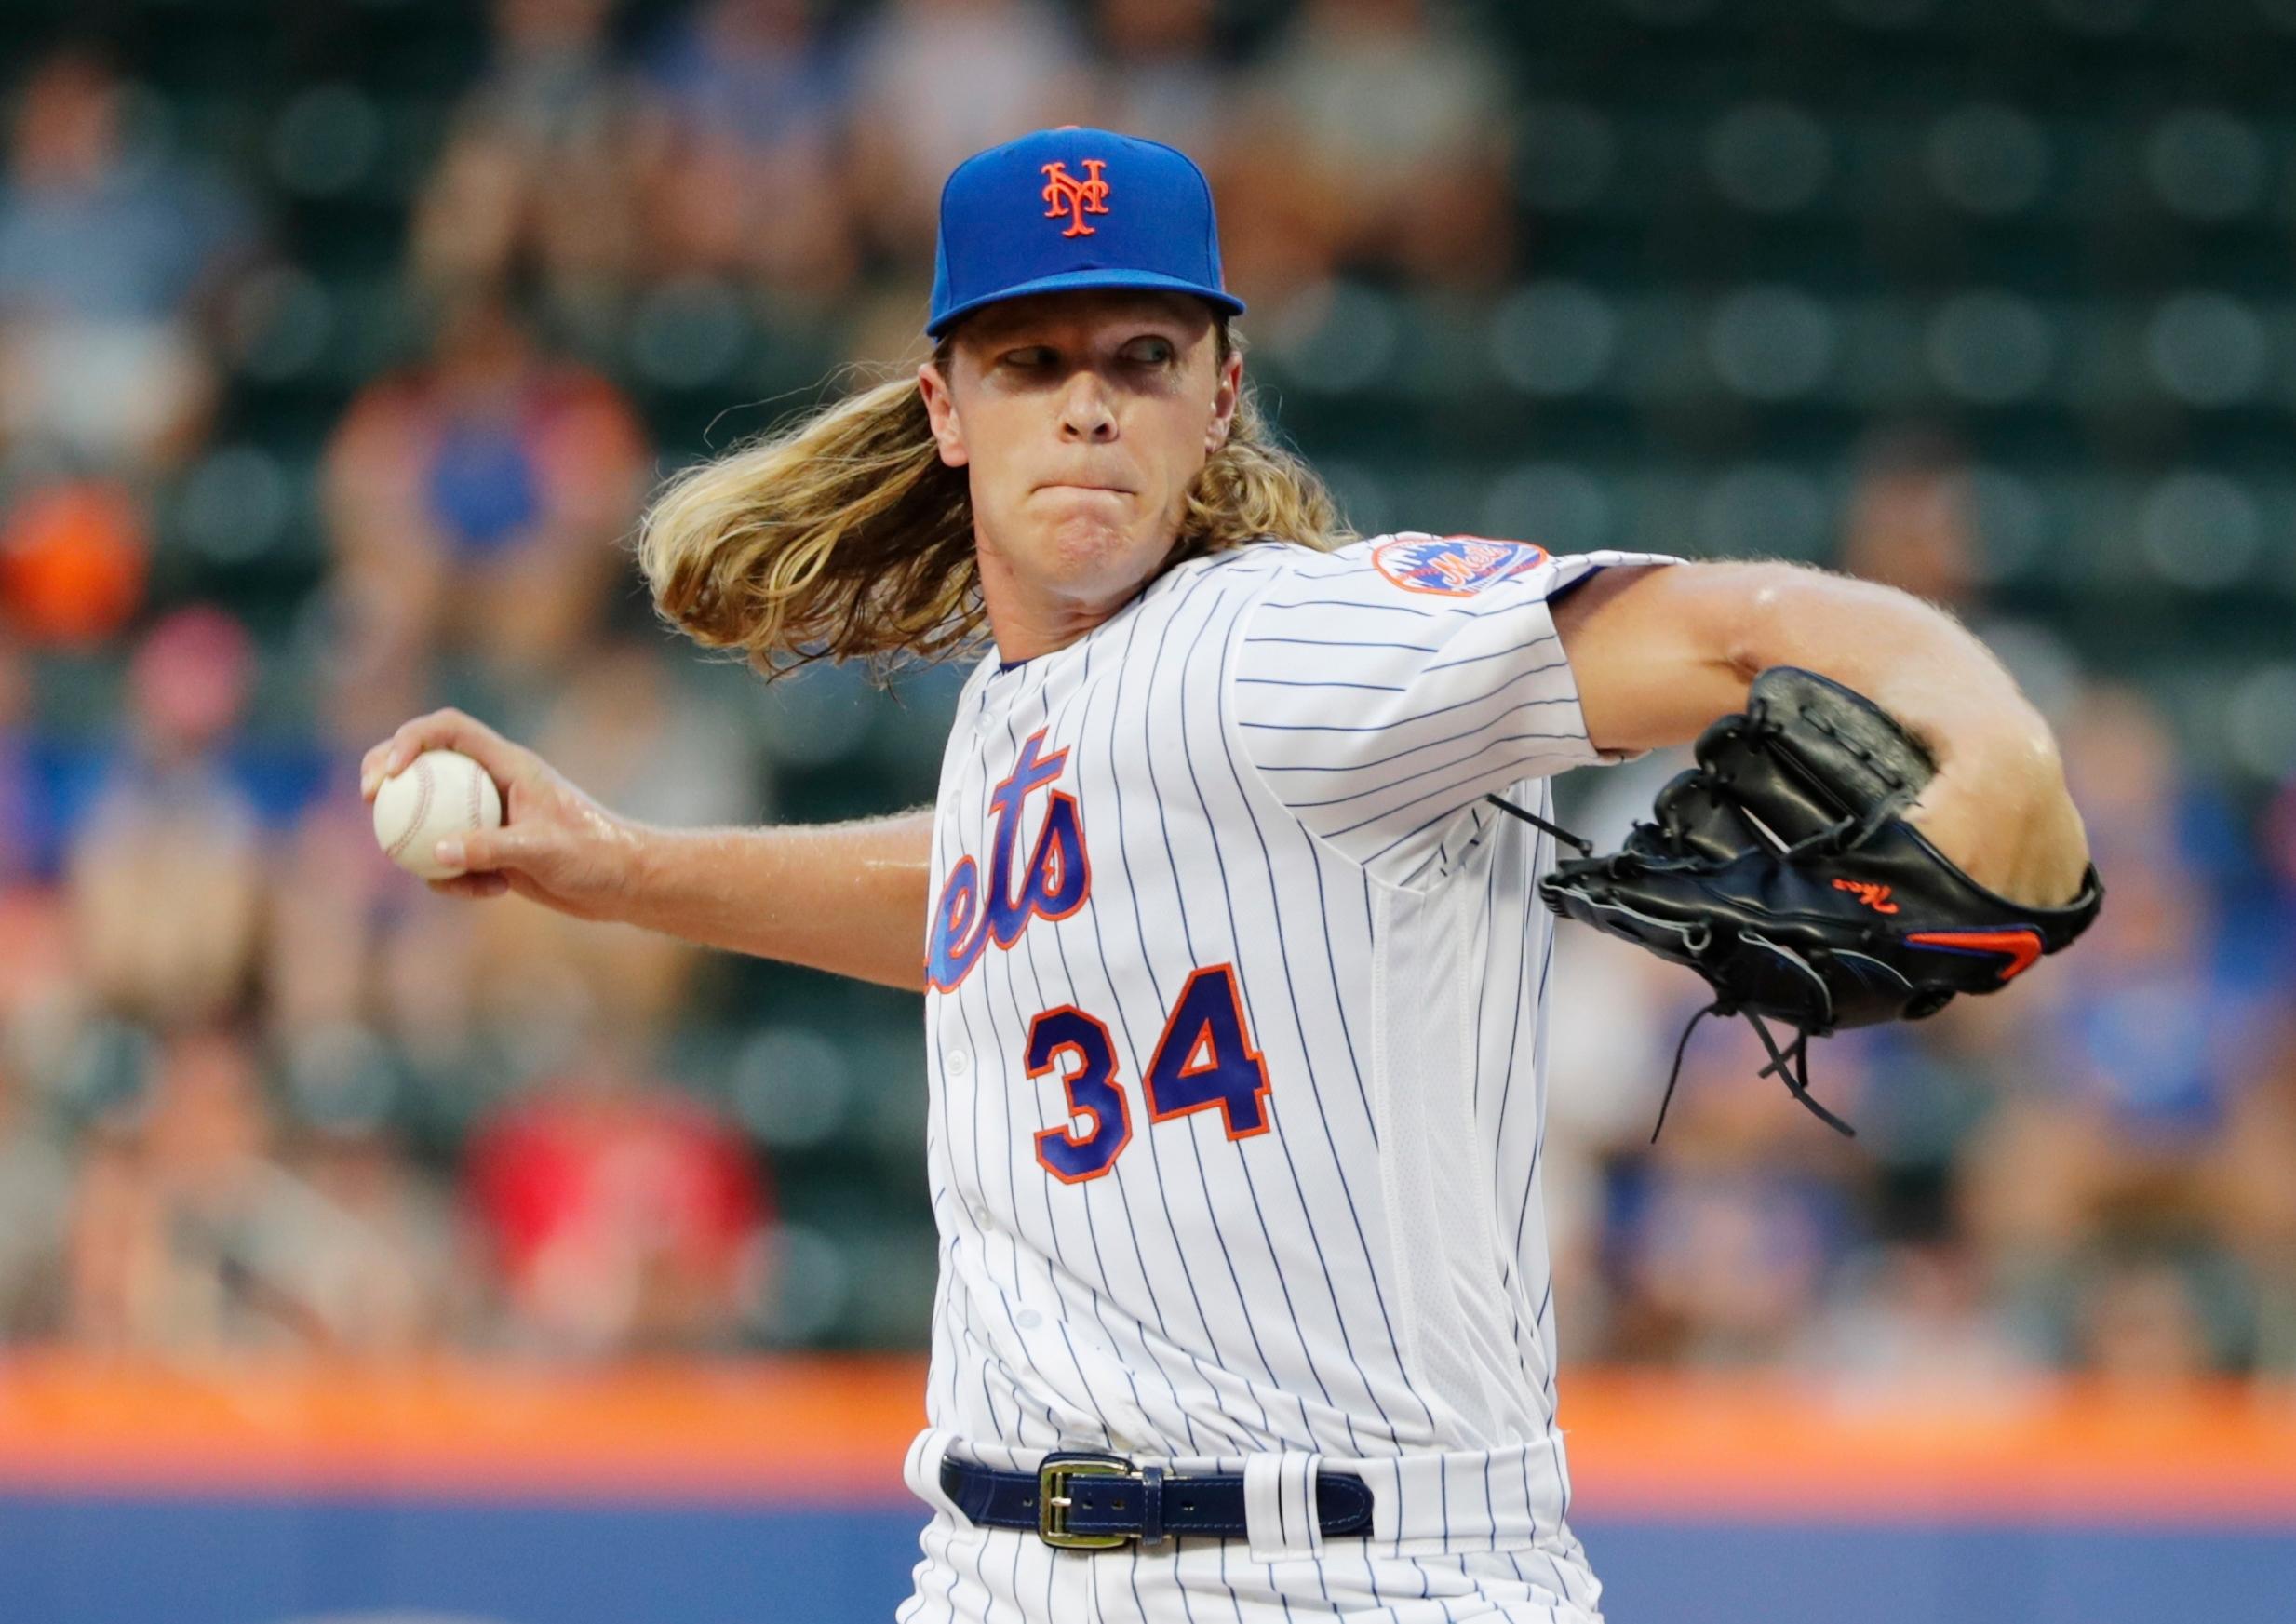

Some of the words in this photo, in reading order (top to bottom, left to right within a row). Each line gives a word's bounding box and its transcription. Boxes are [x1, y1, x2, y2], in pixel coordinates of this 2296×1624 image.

[1041, 159, 1110, 237] NY
[1428, 543, 1512, 587] Mets
[924, 725, 1091, 995] ets
[1025, 962, 1271, 1184] 34
